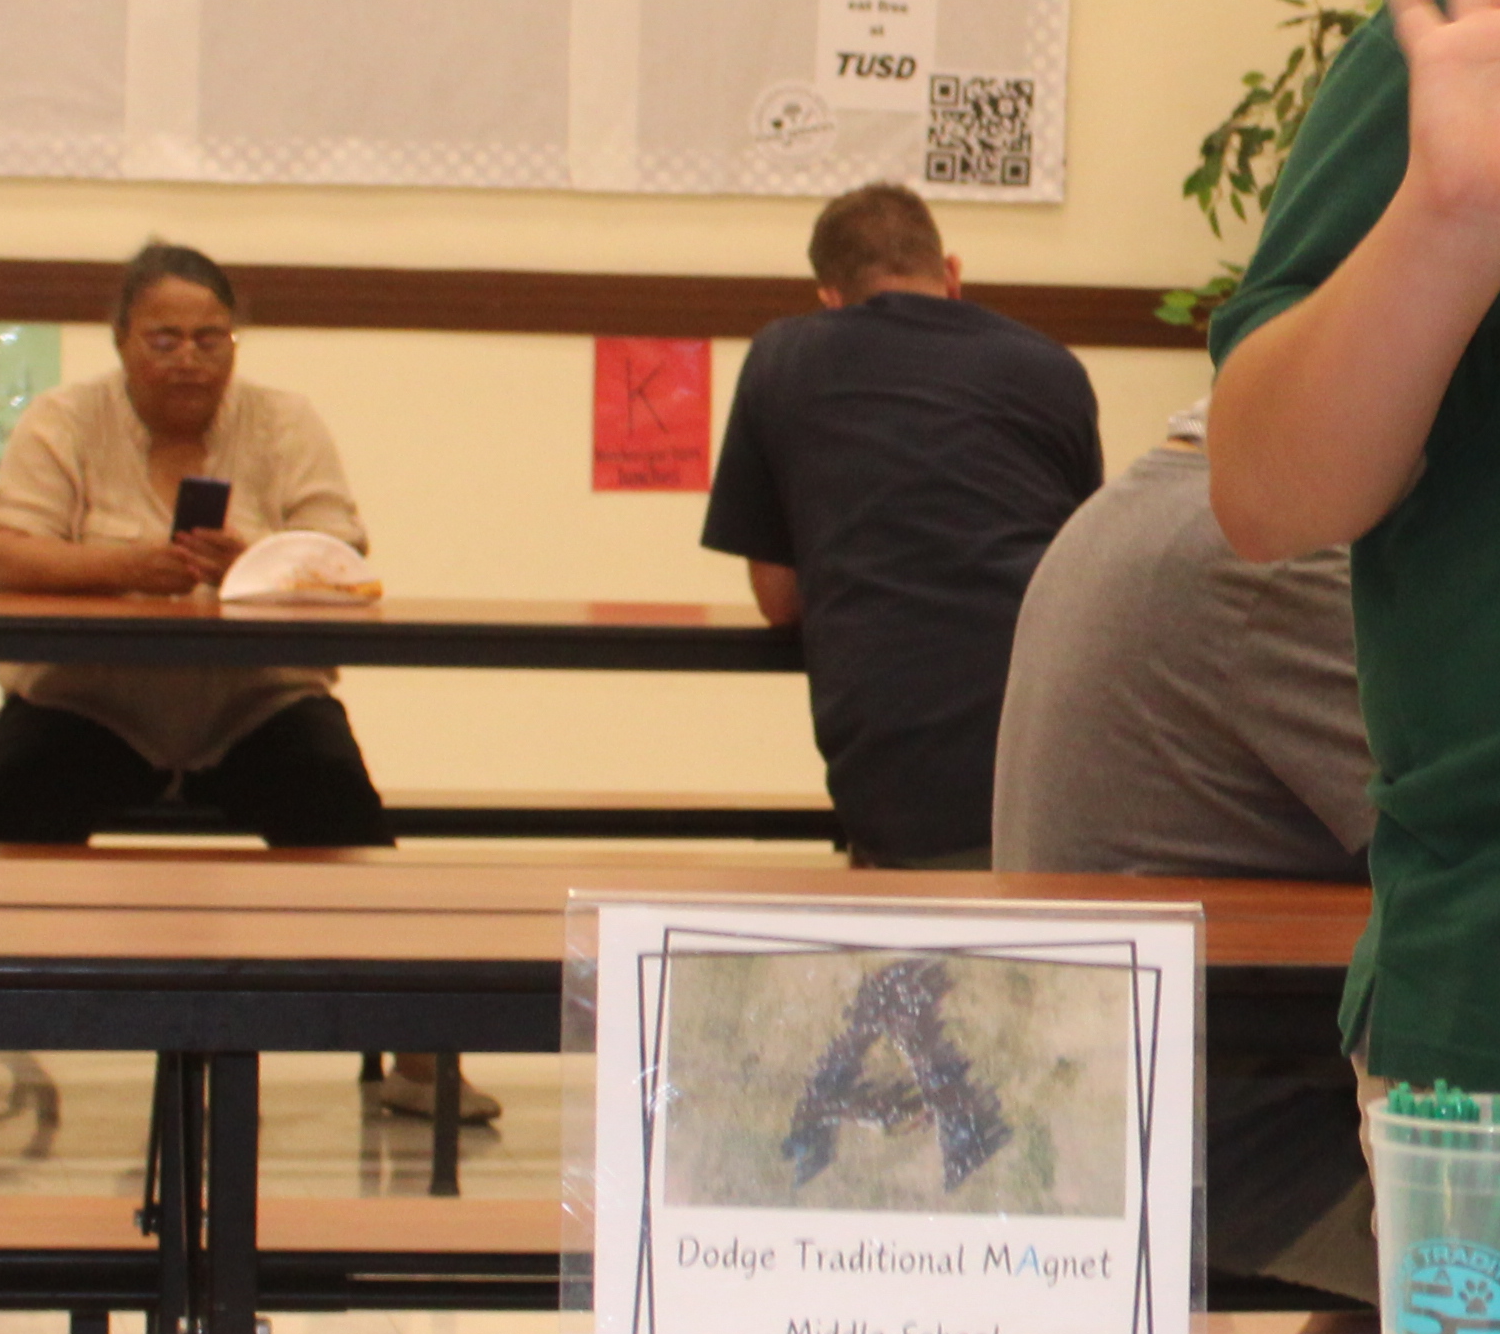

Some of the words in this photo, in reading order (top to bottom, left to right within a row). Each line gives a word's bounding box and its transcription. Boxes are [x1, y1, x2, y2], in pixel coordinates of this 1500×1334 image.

[836, 51, 917, 81] TUSD
[625, 356, 670, 437] K
[677, 1235, 776, 1281] Dodge
[794, 1237, 967, 1277] Traditional
[982, 1242, 1113, 1288] MAgnet
